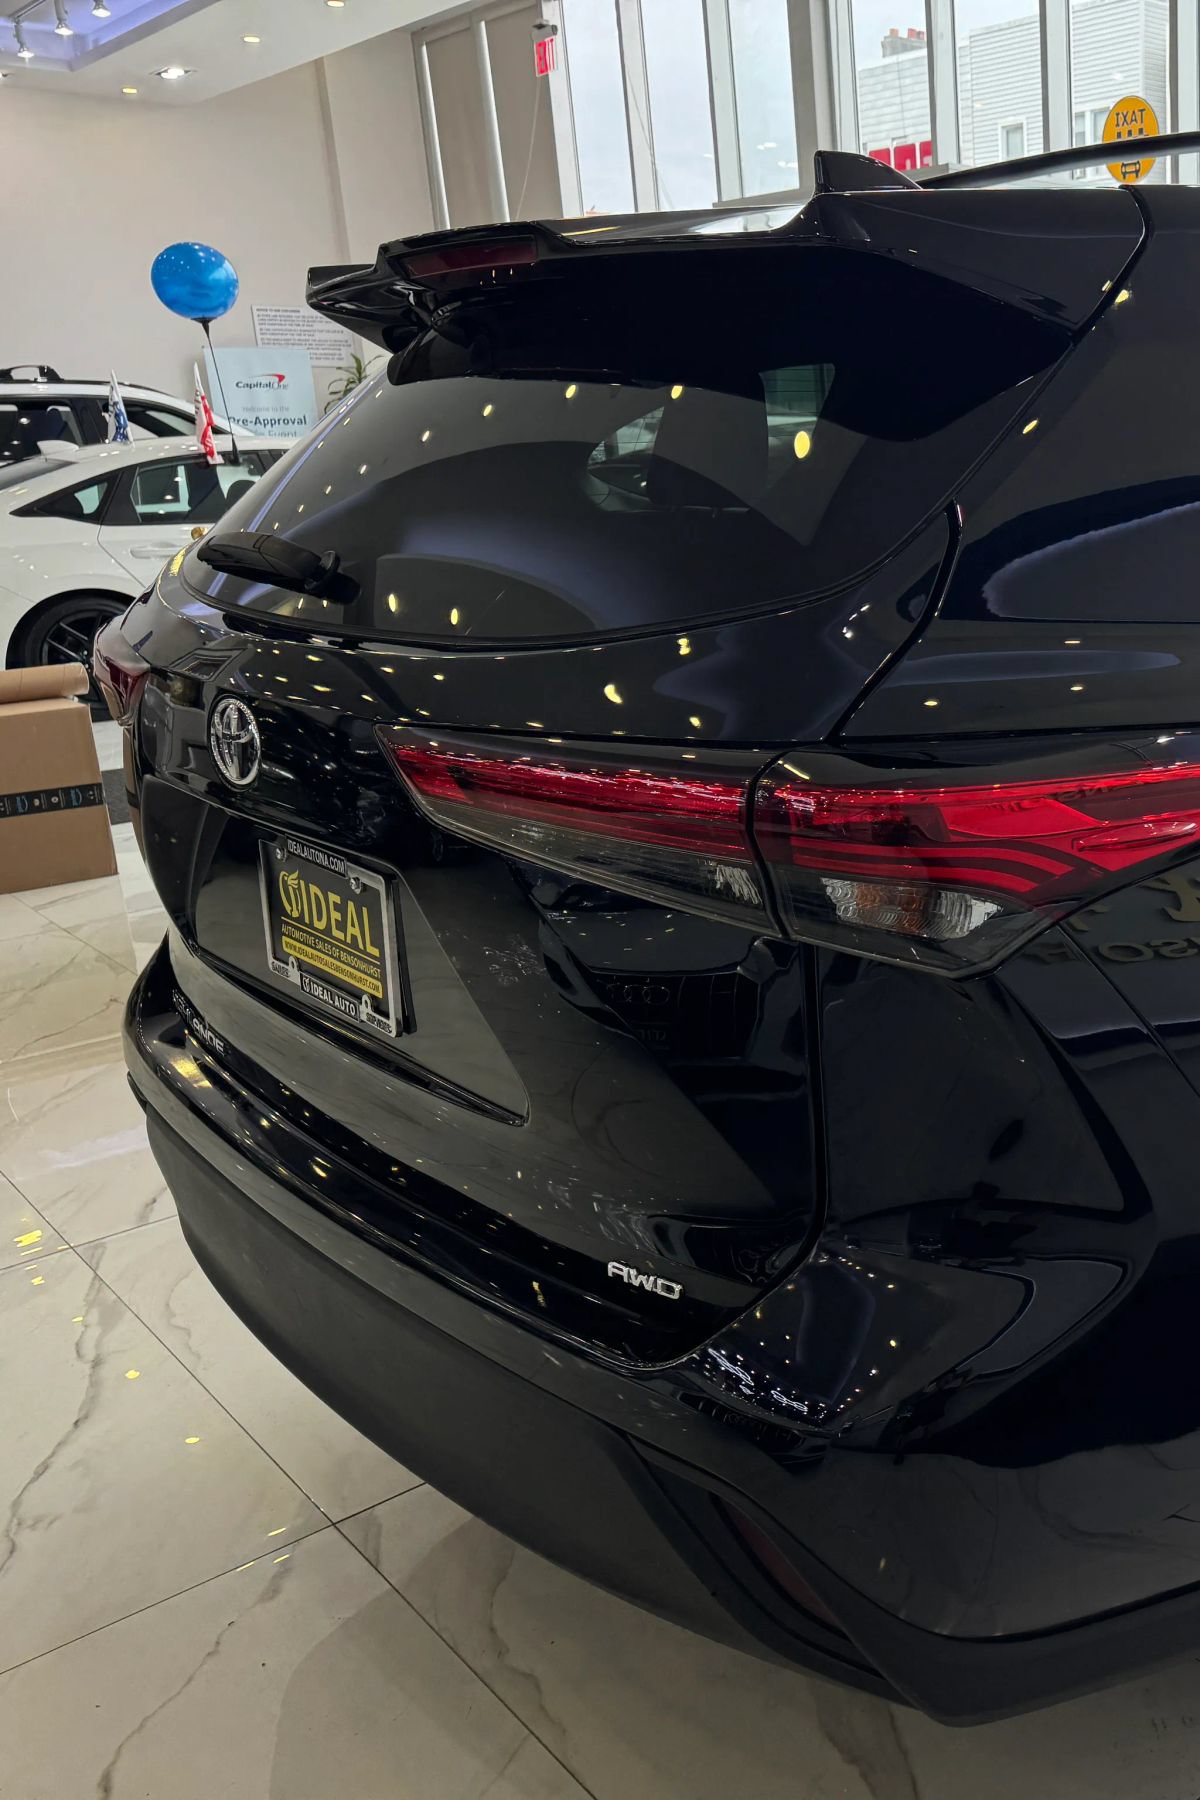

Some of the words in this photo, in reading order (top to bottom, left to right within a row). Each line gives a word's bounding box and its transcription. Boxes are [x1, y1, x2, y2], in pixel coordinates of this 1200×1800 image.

[287, 839, 346, 874] IDEALAUTONA.COM
[300, 878, 380, 957] IDEAL
[281, 924, 316, 947] AUTOMOTIVE
[316, 938, 332, 955] SALES
[340, 951, 381, 978] BENSONHURST
[311, 982, 334, 1005] IDEAL
[335, 997, 356, 1016] AUTO
[607, 1261, 683, 1300] AWD
